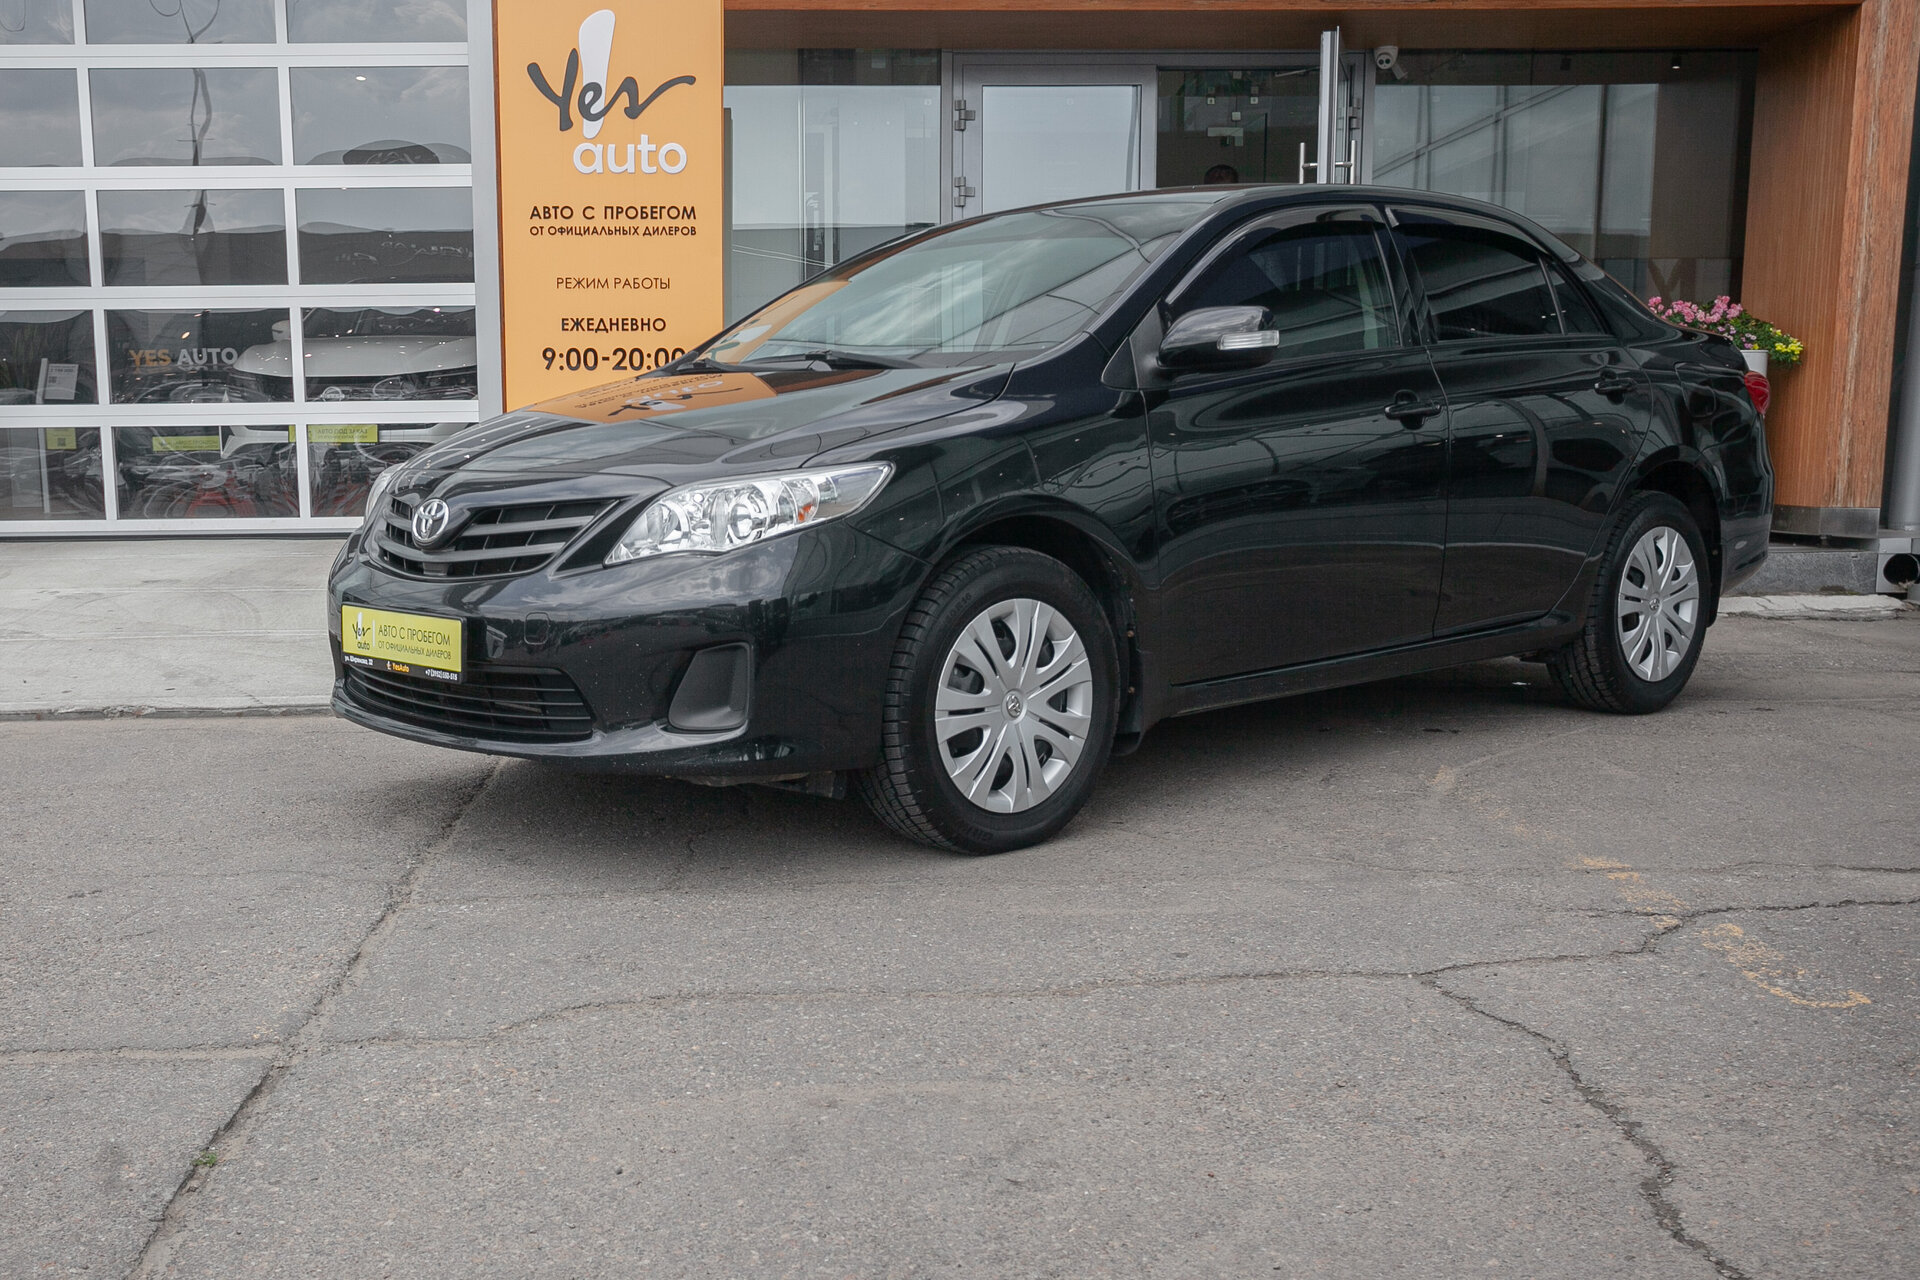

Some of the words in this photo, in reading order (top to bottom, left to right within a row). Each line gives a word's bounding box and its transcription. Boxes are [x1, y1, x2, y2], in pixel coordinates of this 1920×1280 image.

[527, 48, 696, 131] Yes
[573, 134, 688, 174] auto
[530, 206, 574, 220] АВТО
[582, 206, 595, 220] С
[604, 206, 697, 220] ПРОБЕГОМ
[530, 226, 544, 236] ОТ
[547, 226, 639, 237] ОФИЦИАЛЬНЫХ
[642, 226, 697, 237] ДИЛЕРОВ
[556, 277, 609, 289] РЕЖИМ
[613, 277, 671, 289] РАБОТЫ
[561, 317, 667, 333] ЕЖЕДНЕВНО
[129, 349, 172, 367] YES
[177, 347, 238, 365] AUTO
[378, 624, 397, 639] АВТО
[400, 628, 406, 639] С
[407, 628, 451, 646] ПРОБЕГОМ
[357, 642, 370, 650] auto
[386, 642, 424, 655] ОФИЦИАЛЬНЫХ
[426, 648, 451, 660] ДИЛЕРОВ
